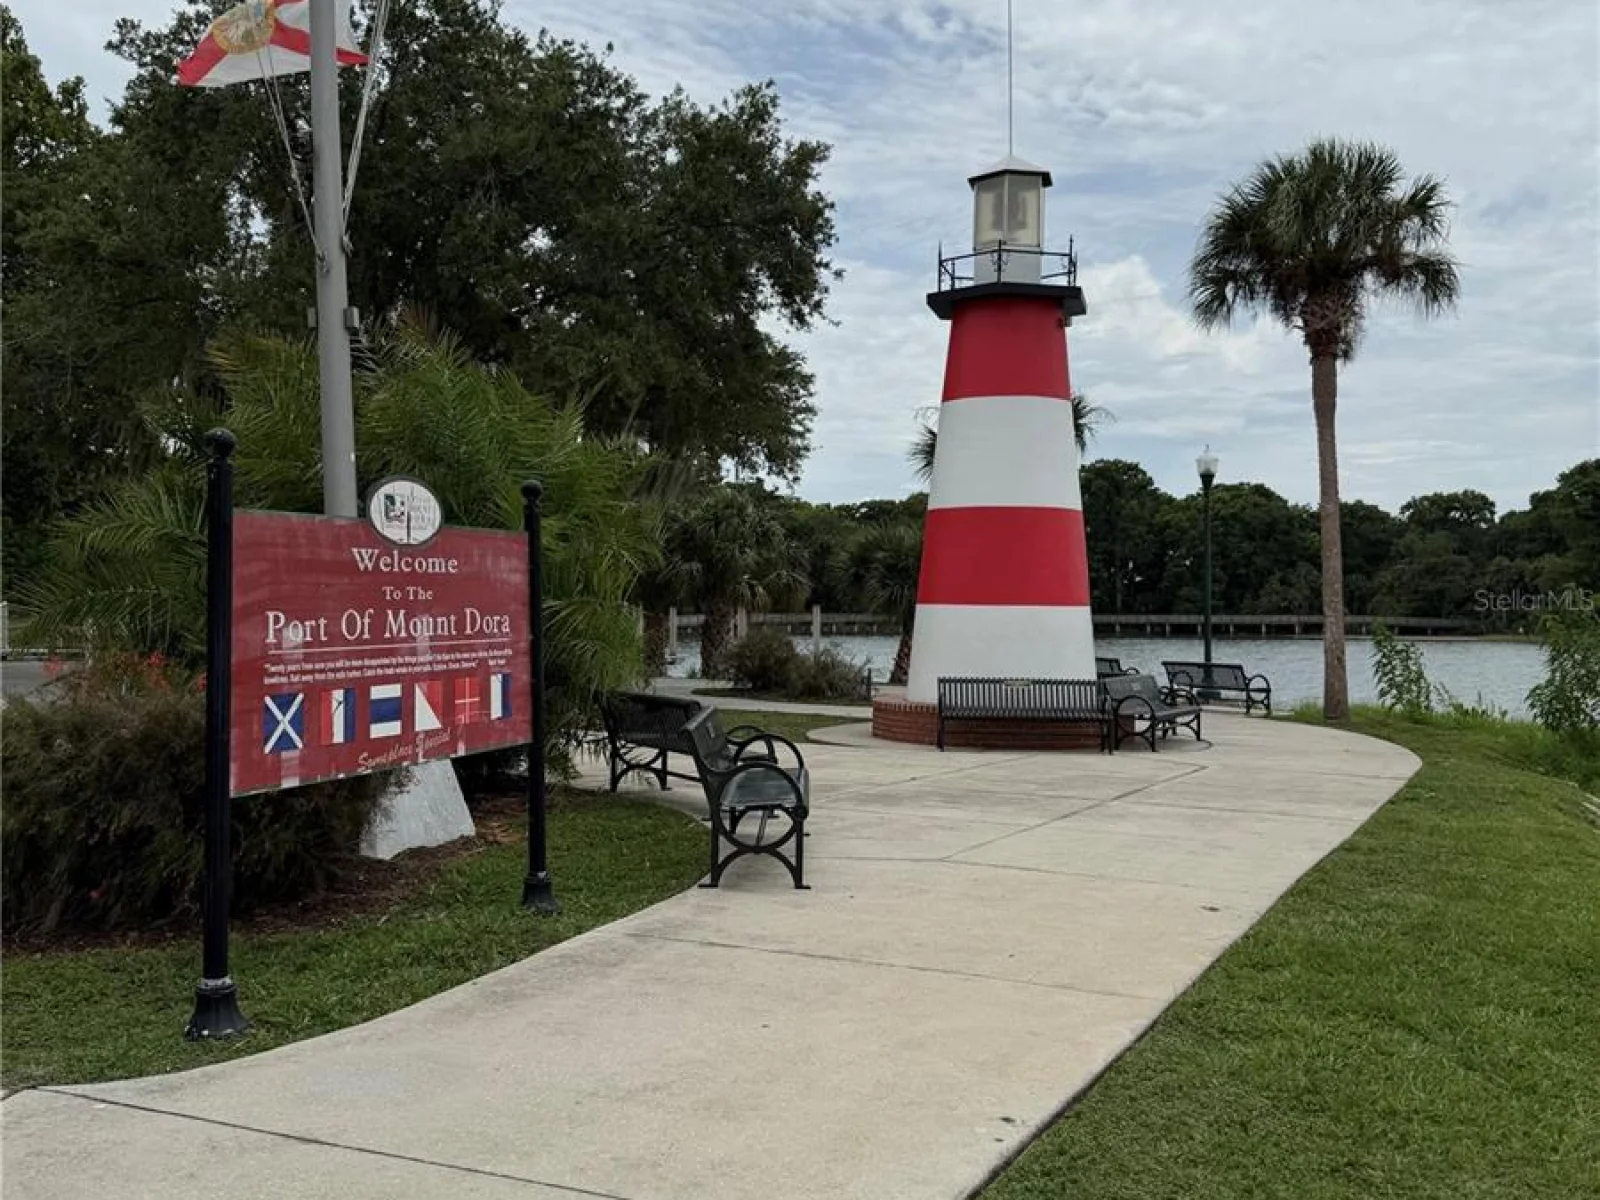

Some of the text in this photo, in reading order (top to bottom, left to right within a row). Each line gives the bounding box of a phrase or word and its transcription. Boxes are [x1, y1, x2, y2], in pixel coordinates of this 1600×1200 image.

[351, 547, 458, 573] Welcome
[382, 586, 433, 600] To The
[264, 607, 511, 643] Port Of Mount Dora
